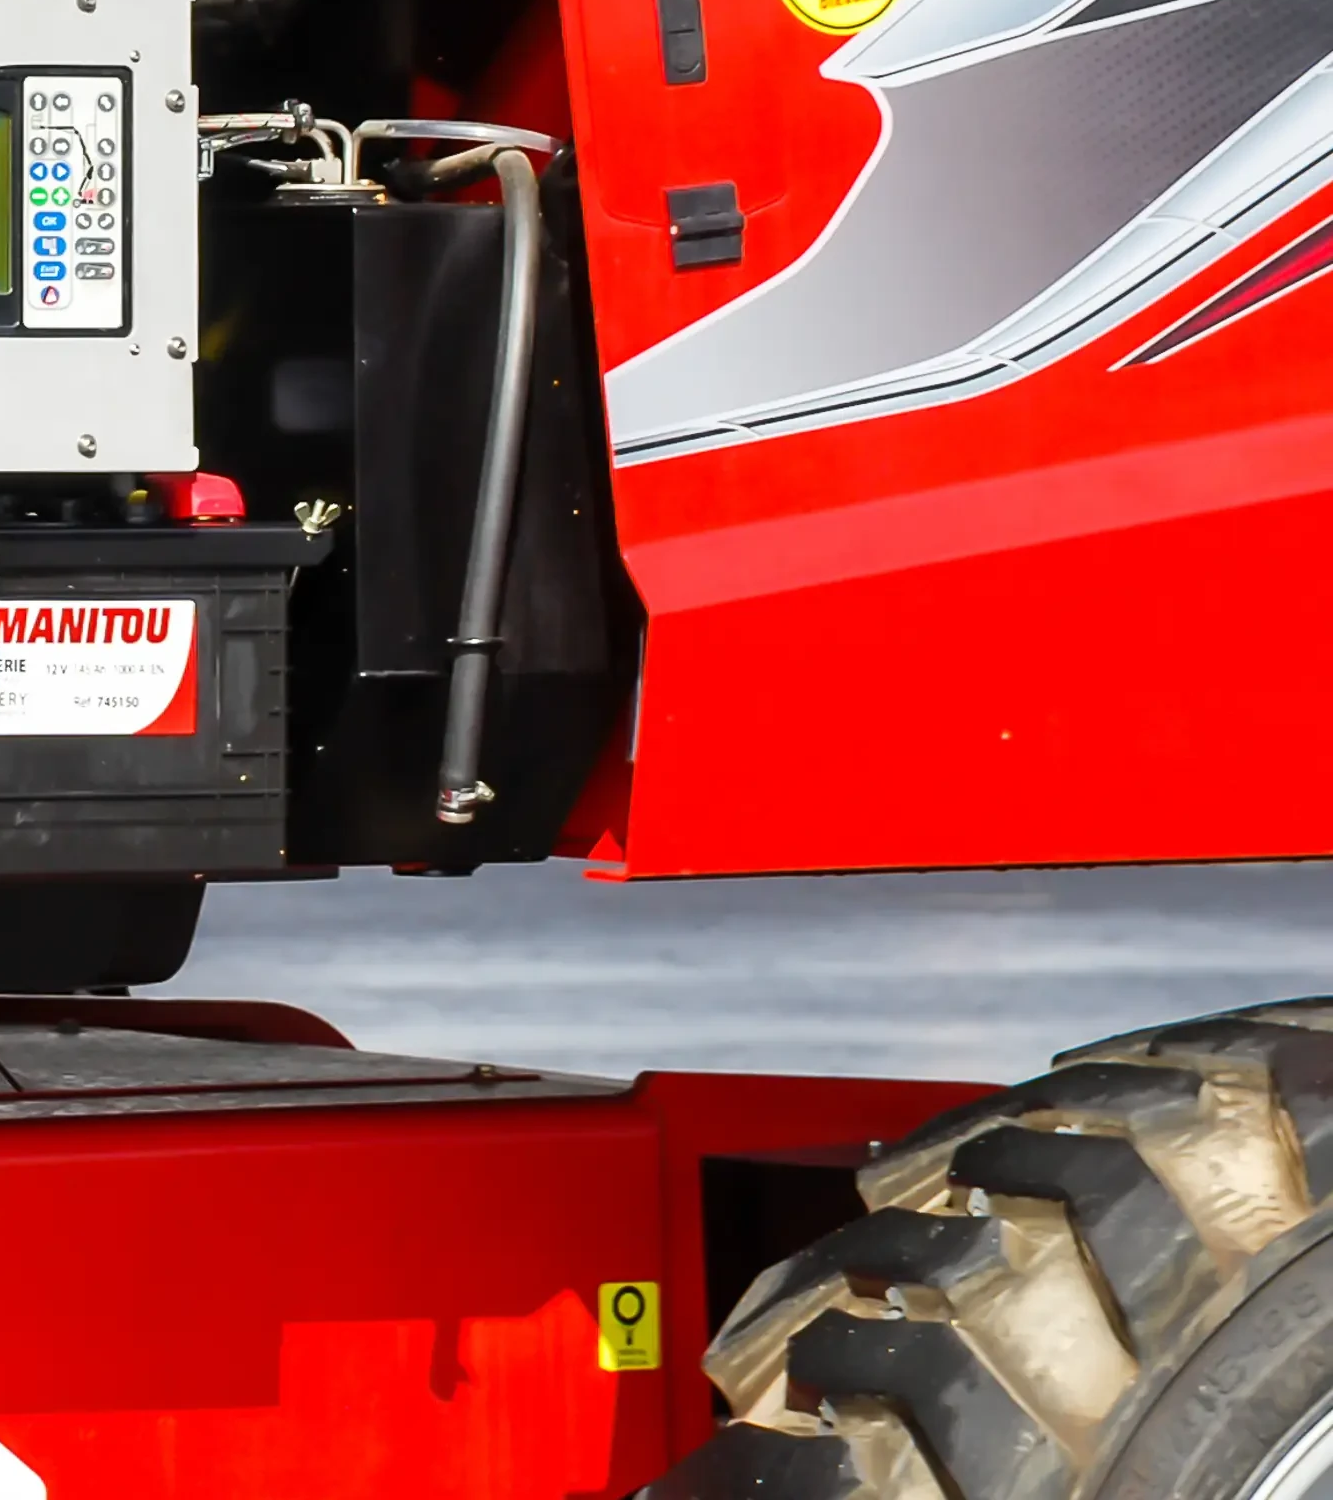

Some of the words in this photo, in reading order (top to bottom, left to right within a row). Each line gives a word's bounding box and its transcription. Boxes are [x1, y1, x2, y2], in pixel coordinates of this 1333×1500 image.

[41, 216, 58, 227] OK
[46, 664, 58, 675] 12
[59, 665, 68, 675] V
[97, 696, 140, 708] 745150
